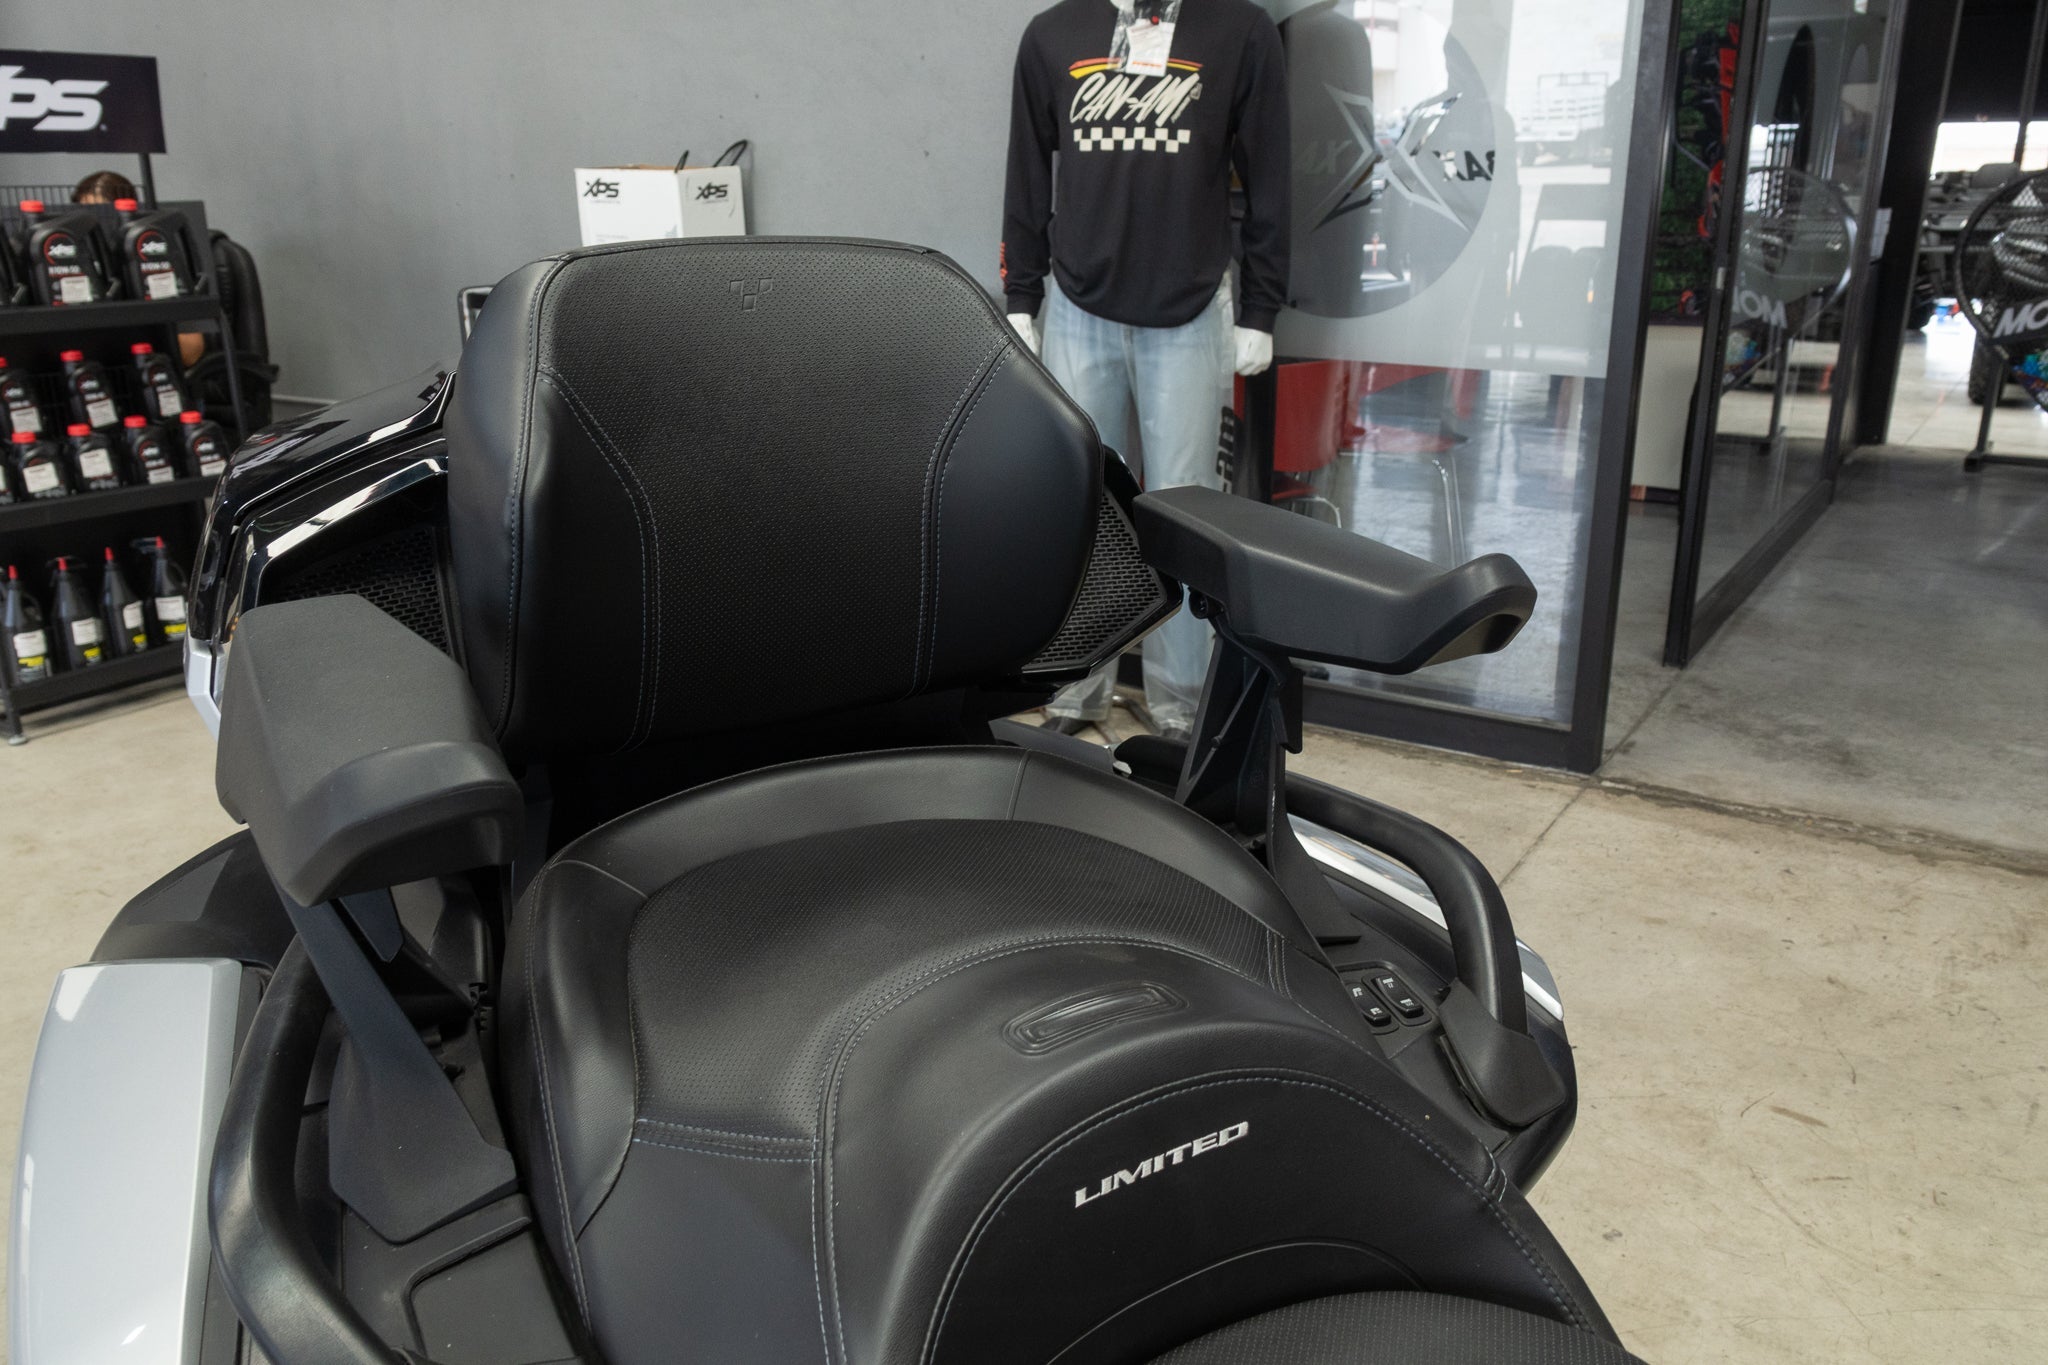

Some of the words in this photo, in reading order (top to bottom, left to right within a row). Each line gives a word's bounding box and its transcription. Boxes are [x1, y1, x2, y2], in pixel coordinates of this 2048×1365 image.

[0, 65, 109, 131] PS
[584, 178, 620, 198] XPS
[695, 181, 728, 200] XPS
[1075, 1121, 1249, 1208] LIMITED
